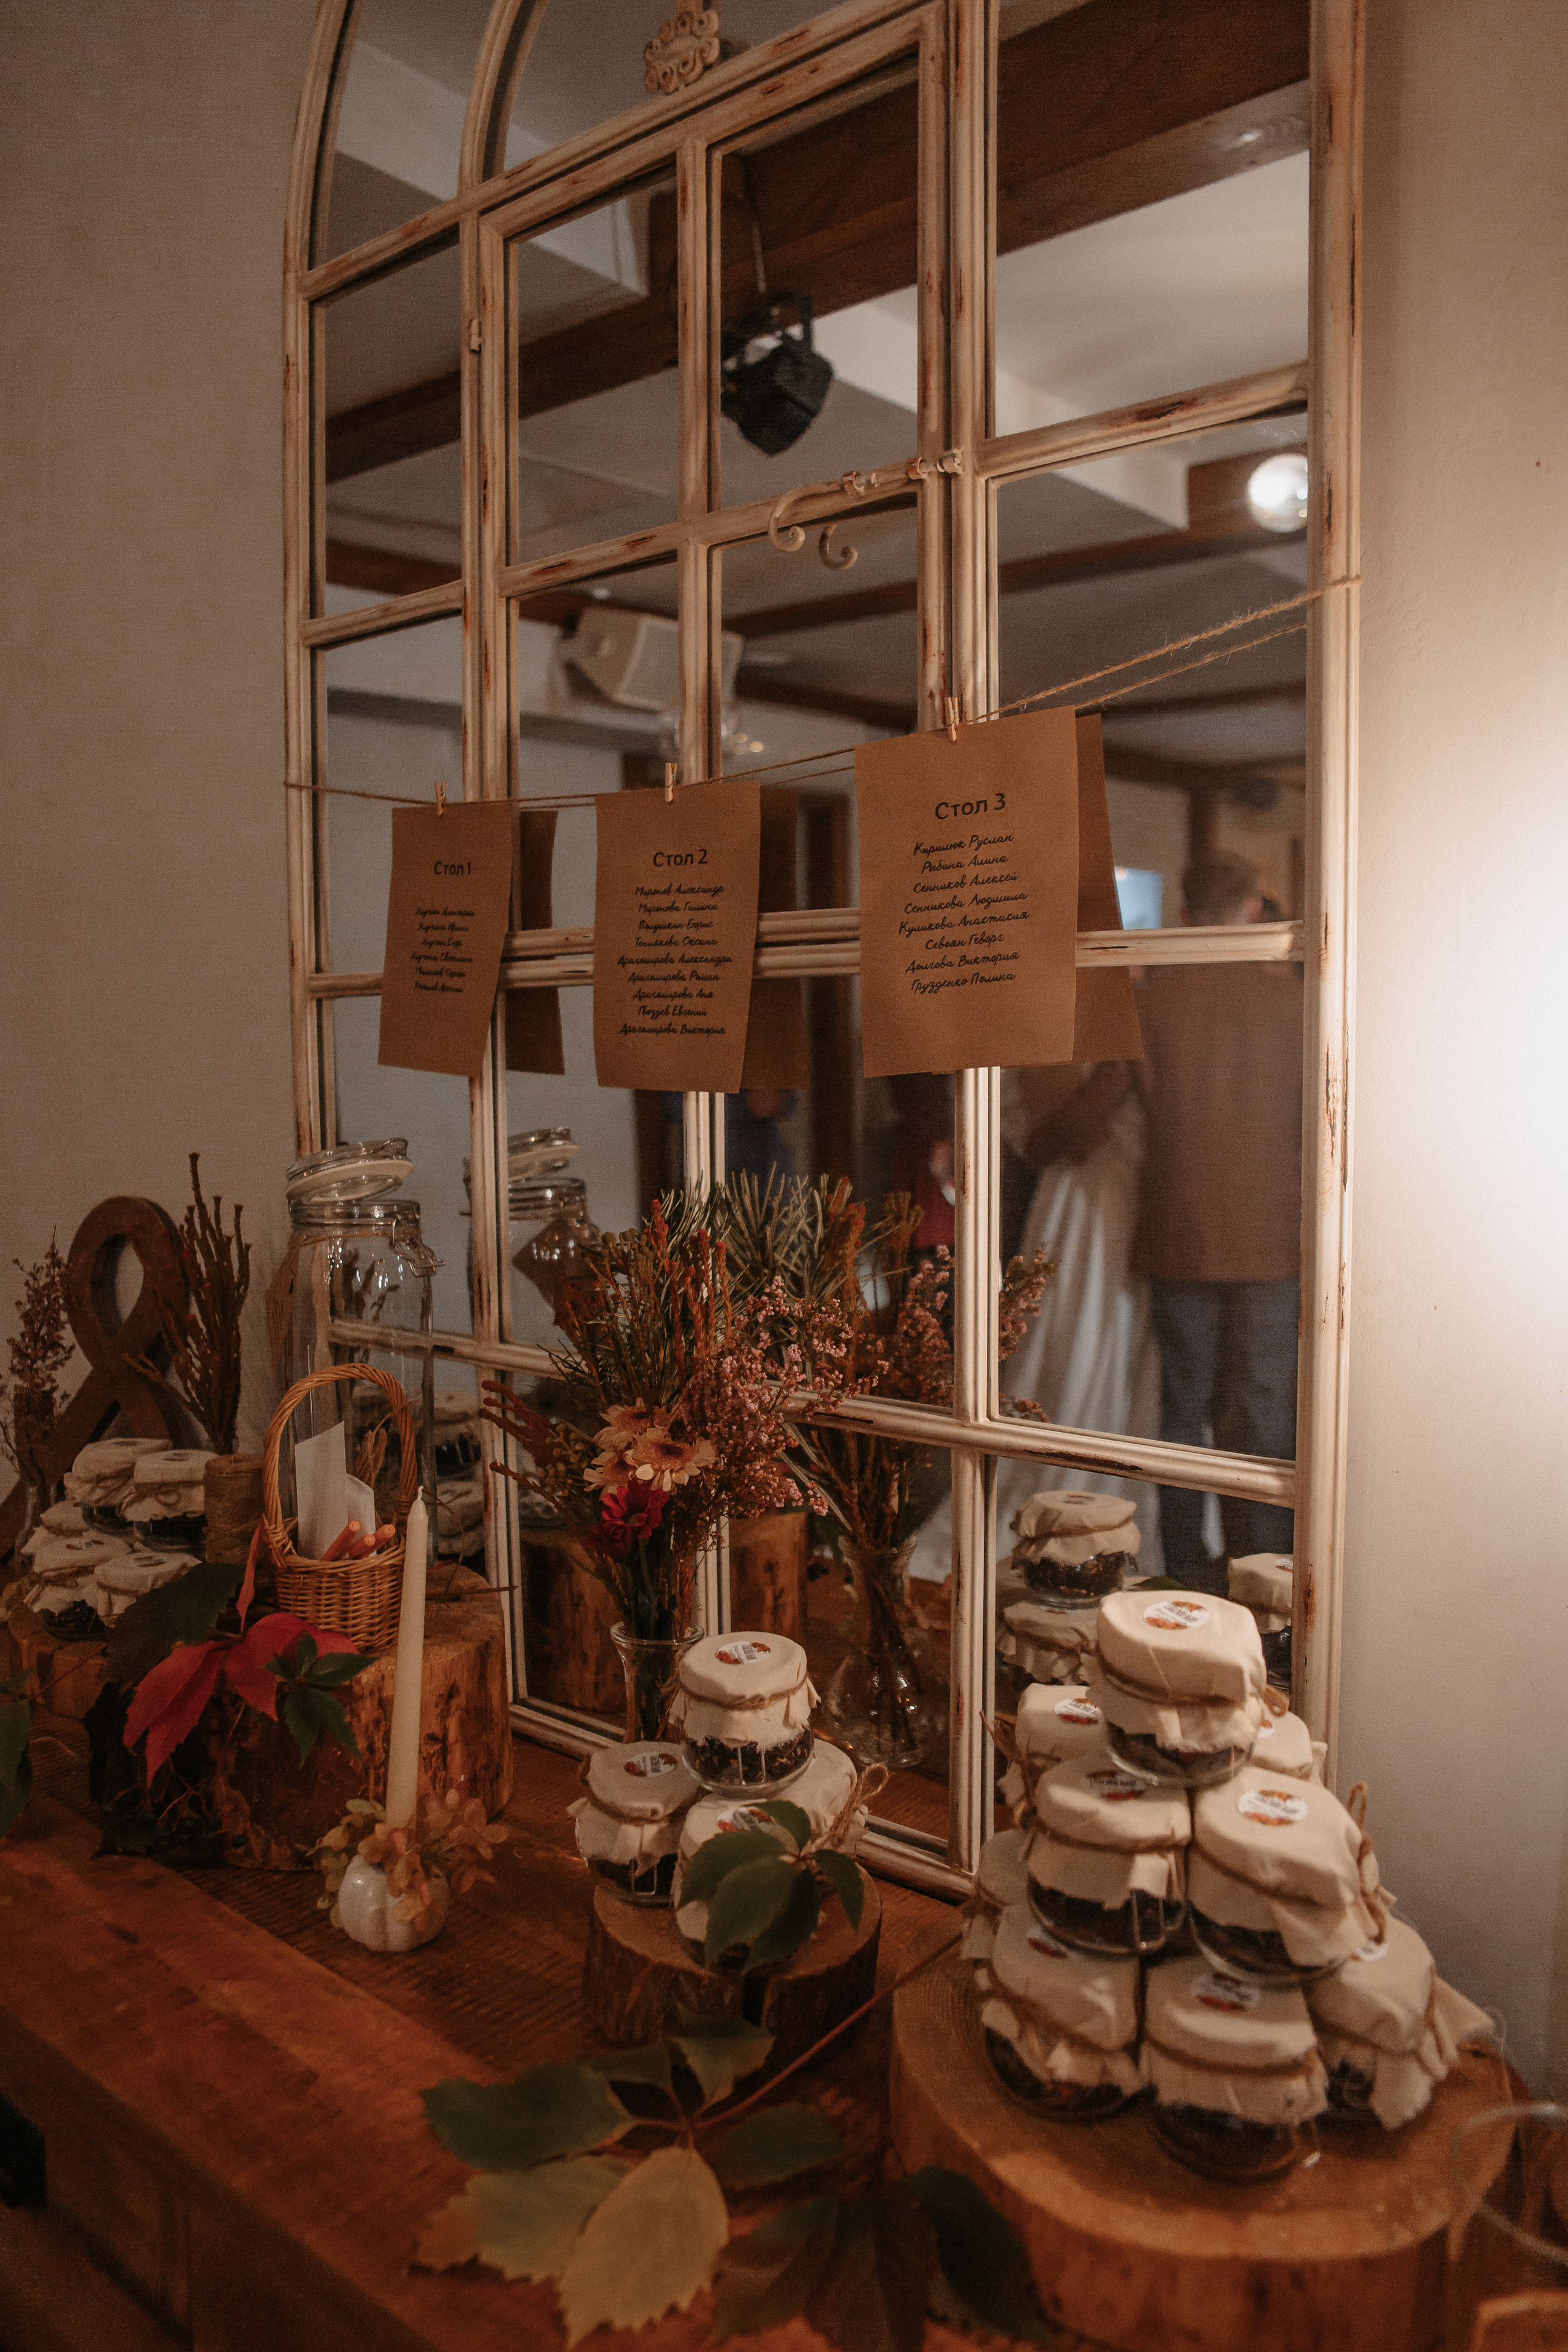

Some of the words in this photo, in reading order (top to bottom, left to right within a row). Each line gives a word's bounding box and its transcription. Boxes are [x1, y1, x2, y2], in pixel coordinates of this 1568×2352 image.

[935, 799, 988, 820] Стол
[993, 793, 1006, 810] 3
[969, 834, 1014, 851] Руслан
[653, 851, 694, 867] Стол
[698, 848, 709, 865] 2
[921, 861, 966, 874] Рыбина
[968, 854, 1009, 867] Алина
[434, 861, 464, 875] Стол
[467, 861, 471, 875] 1
[635, 883, 673, 899] Миронов
[674, 884, 725, 897] Александр
[913, 874, 967, 894] Сенников
[970, 872, 1019, 886] Алексей
[638, 900, 682, 916] Миронова
[684, 901, 719, 912] Галина
[904, 895, 966, 914] Сенникова
[968, 892, 1028, 909] Людмила
[687, 918, 715, 933] Борис
[899, 916, 956, 938] Куликова
[958, 911, 1030, 927] Анастасия
[682, 936, 719, 946] Оксана
[968, 931, 1005, 948] Геворг
[677, 953, 734, 968] Александра
[905, 955, 955, 974] Долгова
[958, 951, 1020, 968] Виктория
[689, 970, 721, 982] Роман
[911, 978, 968, 995] Грузденко
[970, 972, 1016, 985] Полина
[695, 988, 715, 999] Аня
[671, 1004, 708, 1017] Евгений
[679, 1024, 726, 1038] Виктория
